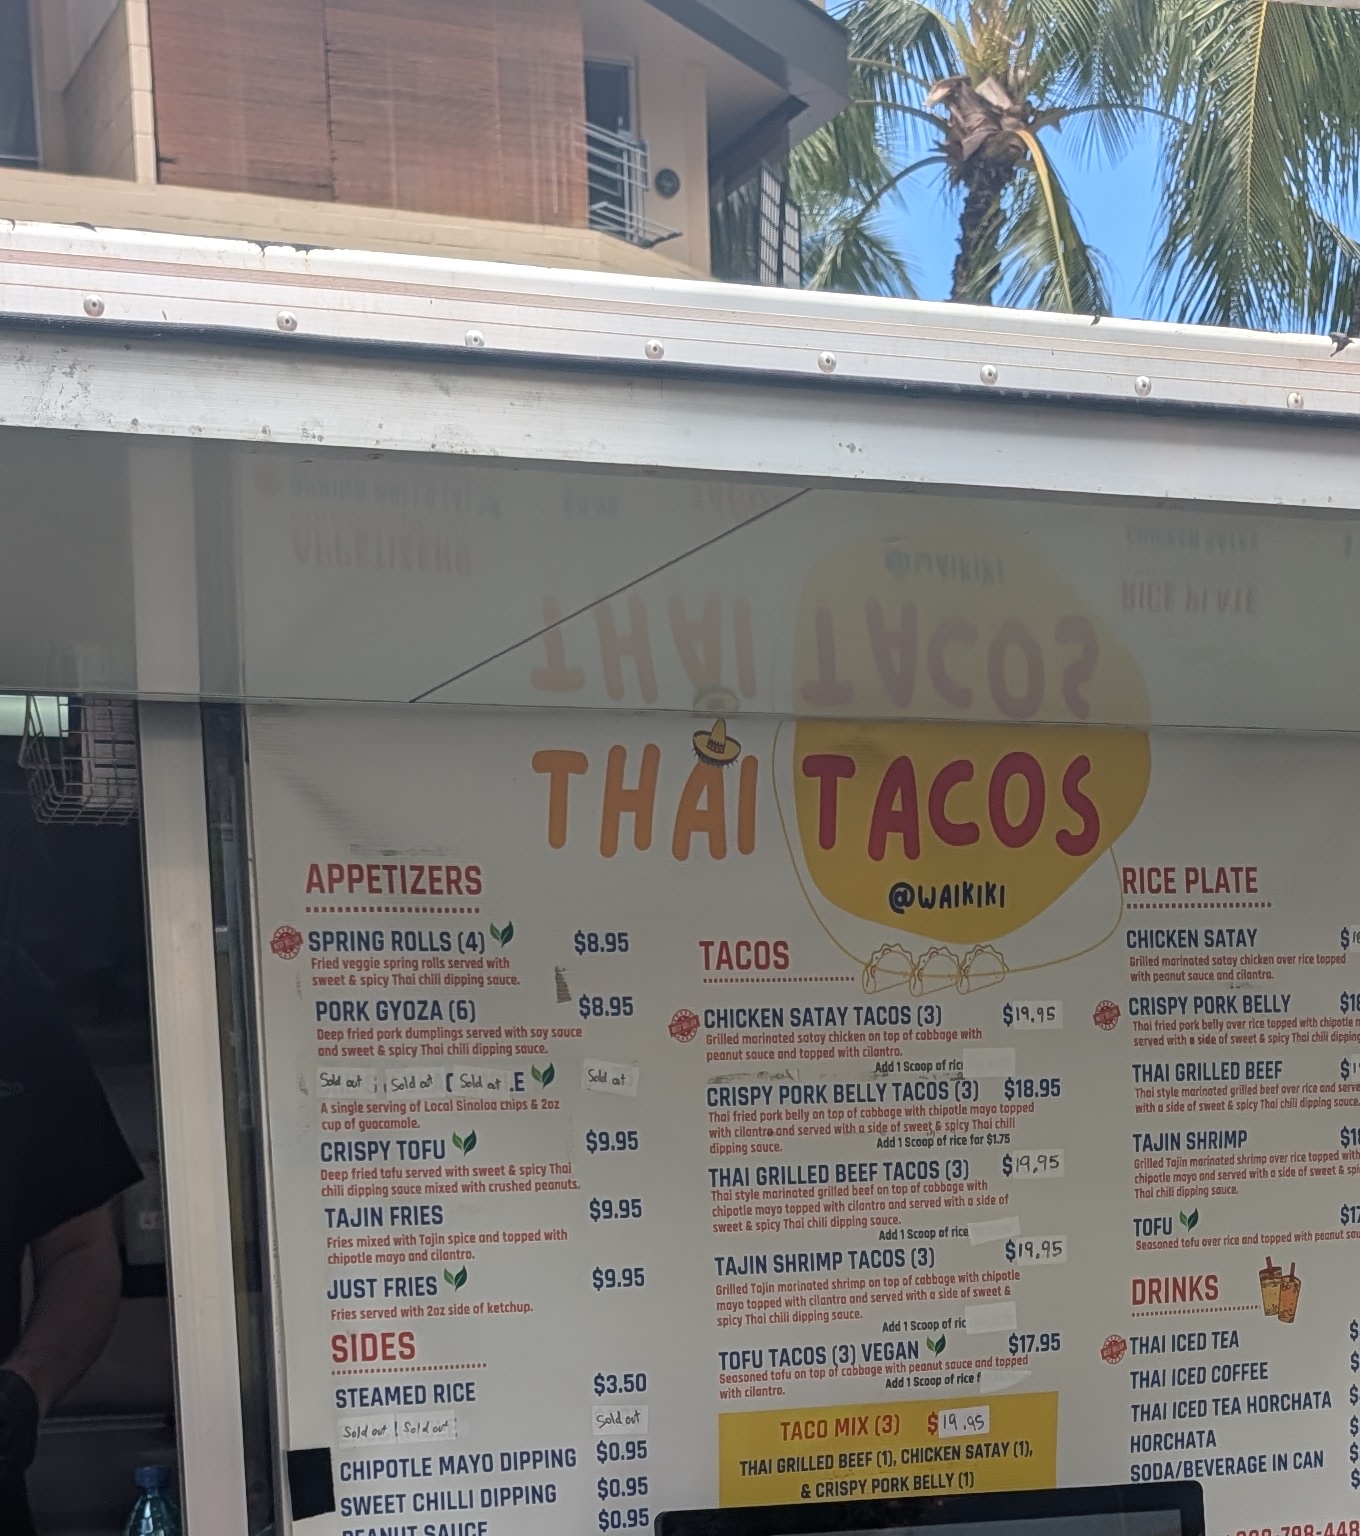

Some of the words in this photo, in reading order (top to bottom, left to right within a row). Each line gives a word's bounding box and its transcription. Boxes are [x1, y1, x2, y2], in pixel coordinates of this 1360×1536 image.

[532, 743, 759, 861] THAI
[802, 751, 1100, 861] TACOS
[306, 864, 482, 896] APPETIZERS
[1123, 867, 1176, 893] RICE
[1185, 867, 1258, 893] PLATE
[888, 880, 1006, 914] @WAIKIKI
[308, 931, 384, 952] SPRING
[391, 931, 451, 952] ROLLS
[458, 931, 485, 954] (4)
[574, 930, 629, 956] $8.95
[311, 957, 339, 970] Fried
[343, 957, 379, 973] veggie
[383, 957, 416, 973] spring
[420, 957, 443, 969] rolls
[447, 957, 483, 969] served
[486, 957, 510, 969] with
[699, 940, 789, 970] TACOS
[704, 1007, 783, 1028] CHICKEN
[790, 1006, 846, 1027] SATAY
[853, 1006, 910, 1026] TACOS
[917, 1005, 942, 1026] (3)
[1129, 997, 1188, 1015] CRISPY
[1194, 996, 1237, 1014] PORK
[1243, 994, 1291, 1013] BELLY
[707, 1086, 773, 1107] CRISPY
[779, 1084, 827, 1105] PORK
[833, 1083, 887, 1103] BELLY
[892, 1082, 949, 1102] TACOS
[955, 1080, 978, 1101] (3)
[1004, 1078, 1060, 1101] $18.95
[320, 1141, 390, 1162] CRISPY
[396, 1139, 446, 1160] TOFU
[586, 1131, 638, 1154] $9.95
[877, 1136, 894, 1148] Add
[897, 1135, 902, 1148] 1
[905, 1135, 934, 1149] Scoop
[937, 1135, 947, 1146] of
[950, 1134, 967, 1146] rice
[970, 1134, 984, 1145] for
[986, 1133, 1010, 1146] $1.75
[1133, 1133, 1180, 1152] TAJIN
[1186, 1130, 1247, 1150] SHRIMP
[1133, 1217, 1172, 1237] TOFU
[1132, 1275, 1219, 1305] DRINKS
[331, 1308, 357, 1321] Fries
[360, 1306, 397, 1320] served
[401, 1305, 424, 1318] with
[427, 1305, 445, 1317] 2oz
[448, 1304, 470, 1316] side
[472, 1303, 484, 1315] of
[487, 1302, 533, 1317] ketchup.
[331, 1331, 415, 1363] SIDES
[1009, 1333, 1060, 1356] $17.95
[1130, 1336, 1165, 1355] THAI
[1171, 1332, 1206, 1352] ICED
[1212, 1330, 1239, 1349] TEA
[719, 1349, 763, 1371] TOFU
[769, 1347, 826, 1368] TACOS
[832, 1345, 856, 1367] (3)
[862, 1341, 919, 1362] VEGAN
[596, 1411, 621, 1428] Sold
[625, 1410, 640, 1425] out
[781, 1419, 828, 1441] TACO
[835, 1417, 869, 1438] MIX
[875, 1414, 900, 1436] (3)
[597, 1440, 647, 1464] $0.95
[340, 1457, 432, 1481] CHIPOTLE
[439, 1453, 493, 1477] MAYO
[500, 1448, 576, 1472] DIPPING
[598, 1508, 649, 1532] $0.95
